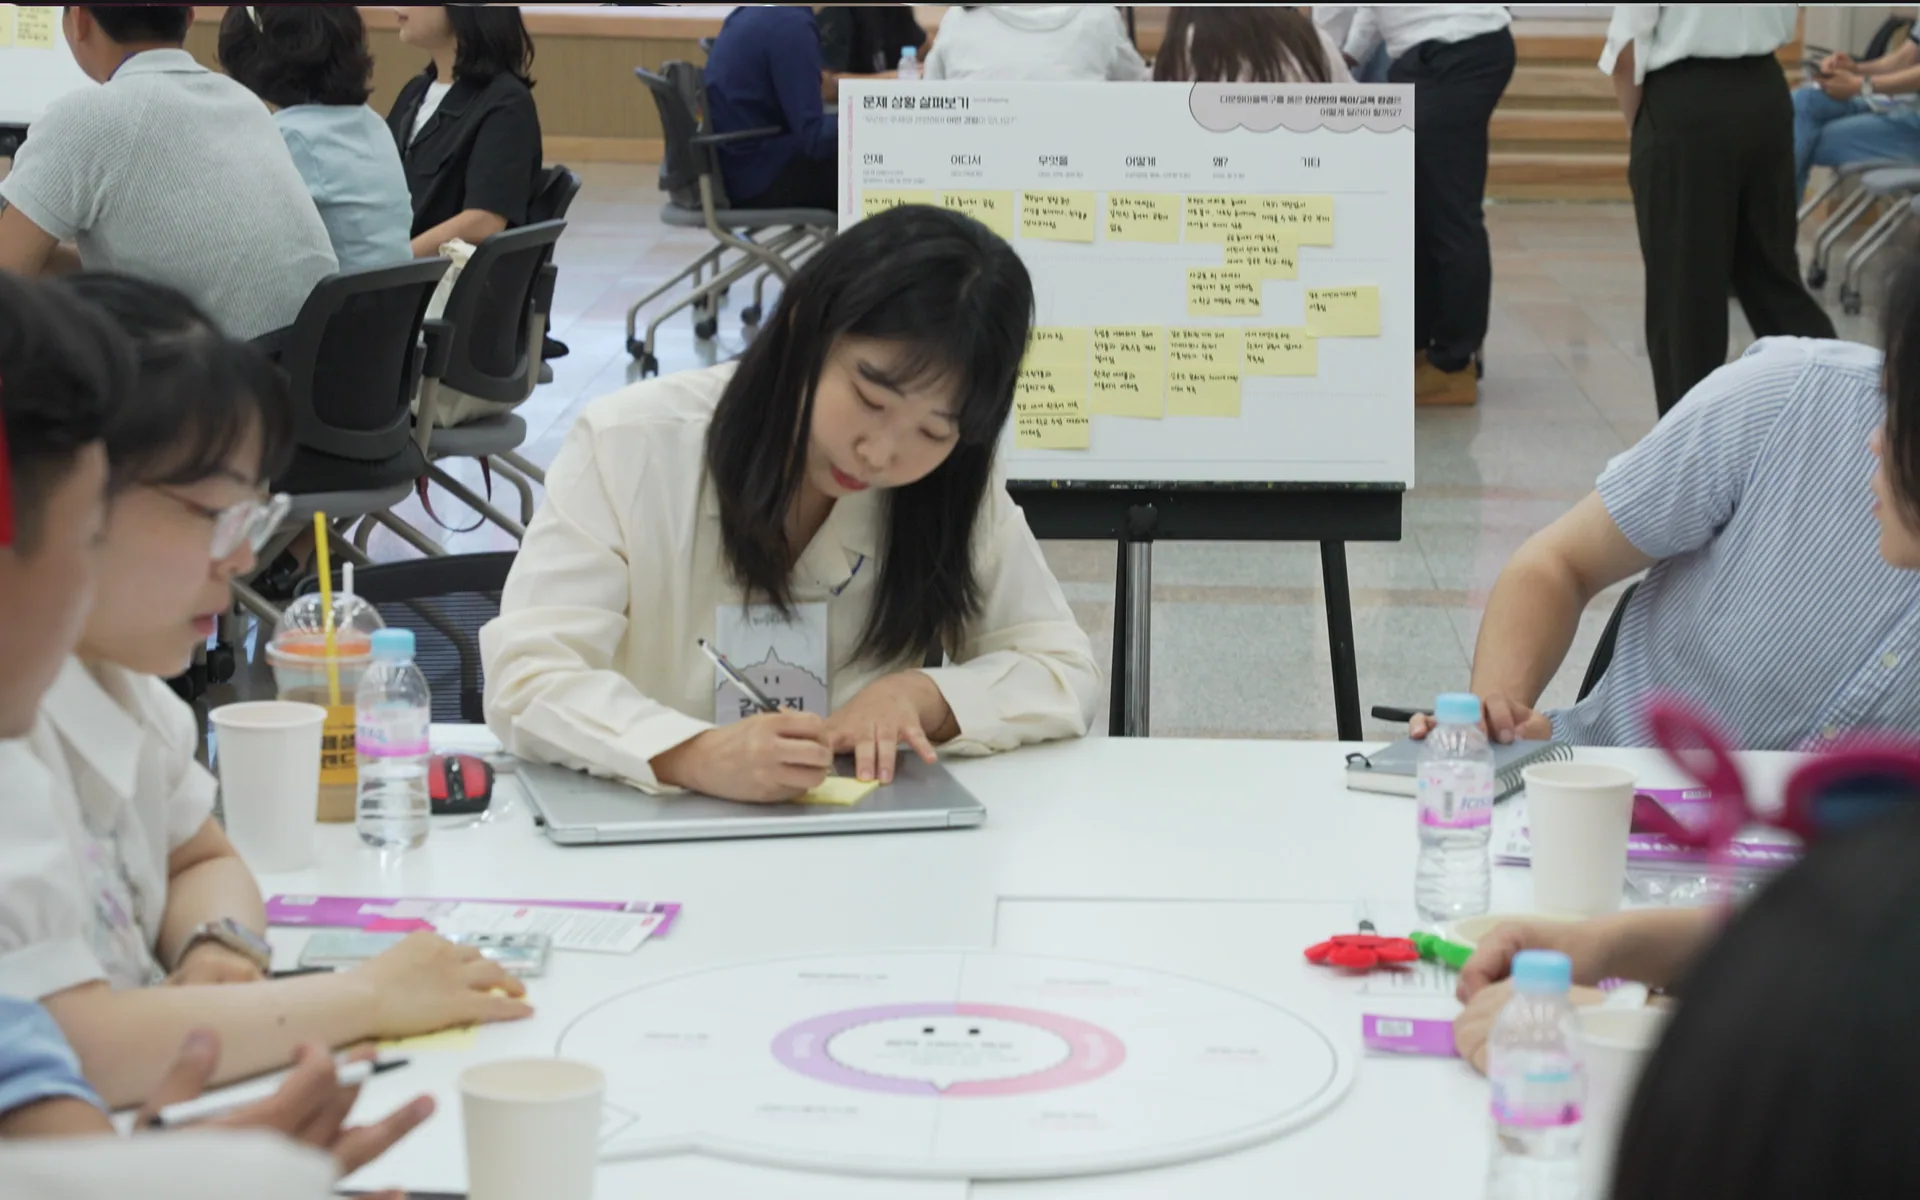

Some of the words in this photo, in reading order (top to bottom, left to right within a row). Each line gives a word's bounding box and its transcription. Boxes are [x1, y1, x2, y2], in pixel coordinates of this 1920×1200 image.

[863, 95, 888, 109] 문제
[891, 95, 916, 109] 상황
[919, 95, 970, 109] 살펴보기
[863, 153, 884, 165] 언제
[950, 154, 982, 166] 어디서
[1037, 155, 1068, 167] 무엇을
[1125, 155, 1156, 168] 어떻게
[1212, 155, 1229, 168] 왜?
[1301, 156, 1321, 169] 기타
